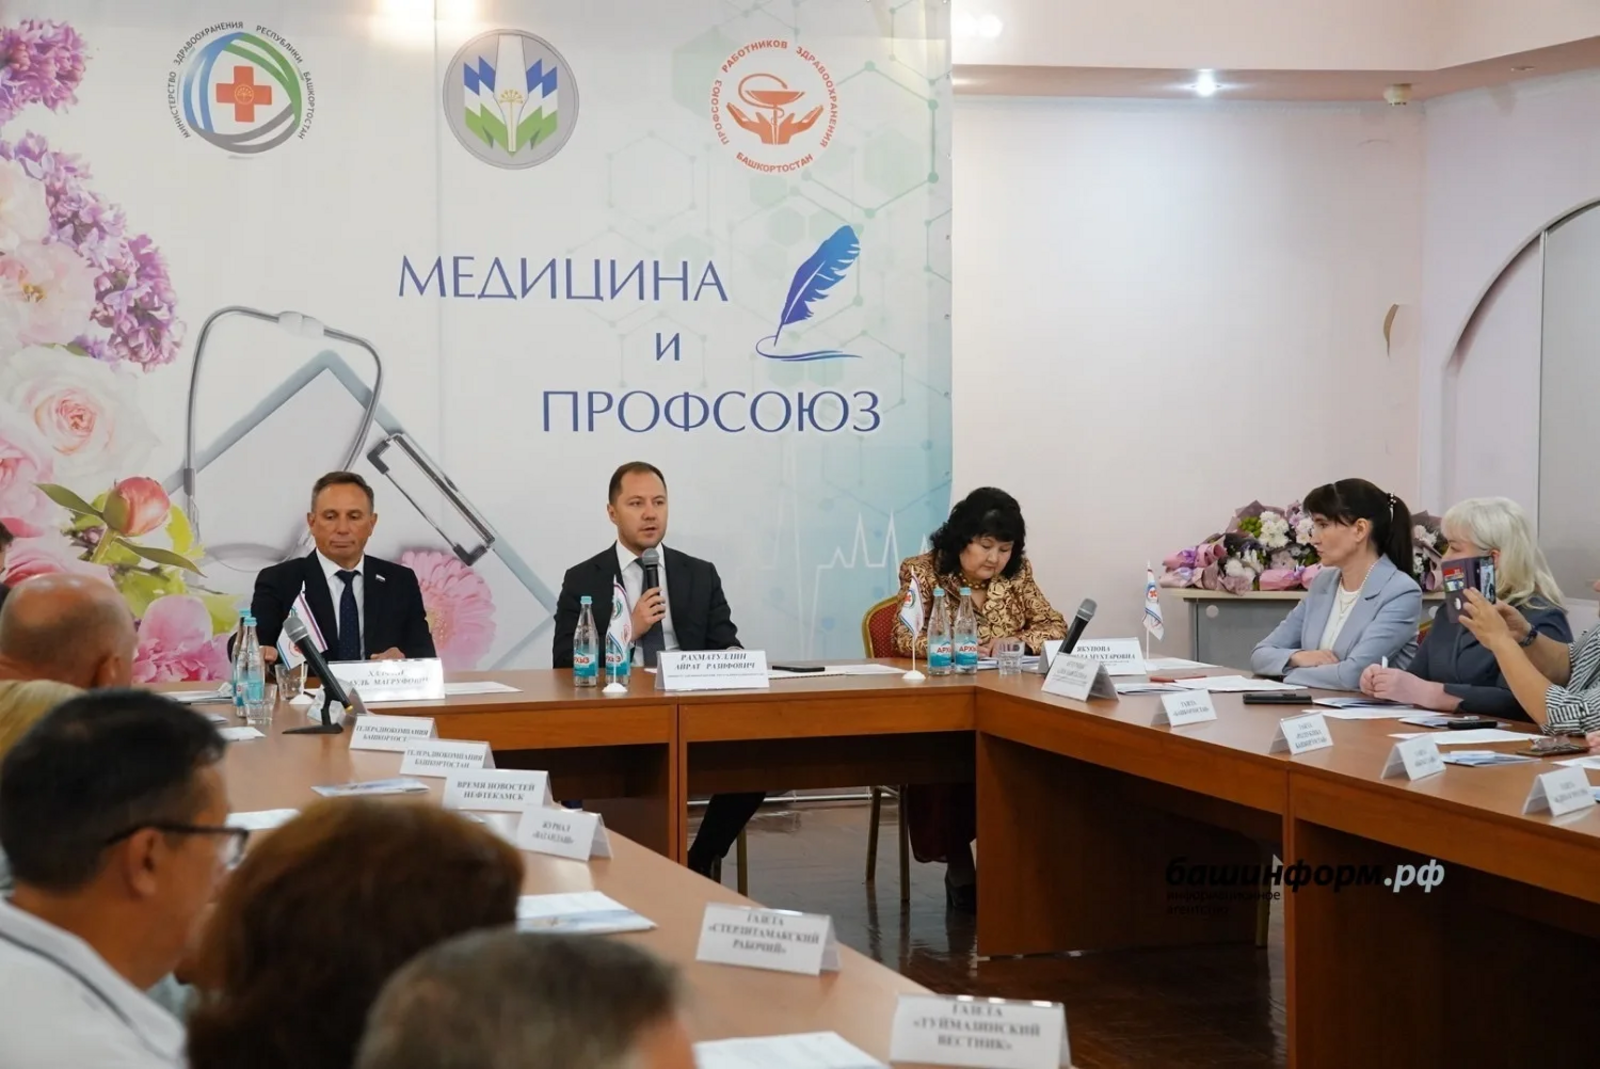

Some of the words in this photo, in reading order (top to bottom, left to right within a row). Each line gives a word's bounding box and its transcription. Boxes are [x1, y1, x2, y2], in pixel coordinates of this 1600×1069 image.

[173, 21, 244, 66] ЗДРАВООХРАНЕНИЯ
[255, 25, 303, 64] РЕСПУБЛИКИ
[167, 71, 191, 139] МИНИСТЕРСТВО
[297, 71, 316, 140] БАШКОРТОСТАН
[711, 79, 730, 145] ПРОФСОЮЗ
[721, 39, 788, 73] РАБОТНИКОВ
[796, 46, 838, 148] ЗДРАВООХРАНЕНИЯ
[736, 152, 814, 173] БАШКОРТОСТАН
[398, 254, 729, 302] МЕДИЦИНА
[542, 390, 882, 433] ПРОФСОЮЗ
[363, 733, 408, 742] БАШКОРТОСТ
[457, 781, 487, 789] ВРЕМЯ
[487, 782, 535, 791] НОВОСТЕЙ
[463, 791, 524, 800] НЕФТЕКАМСК
